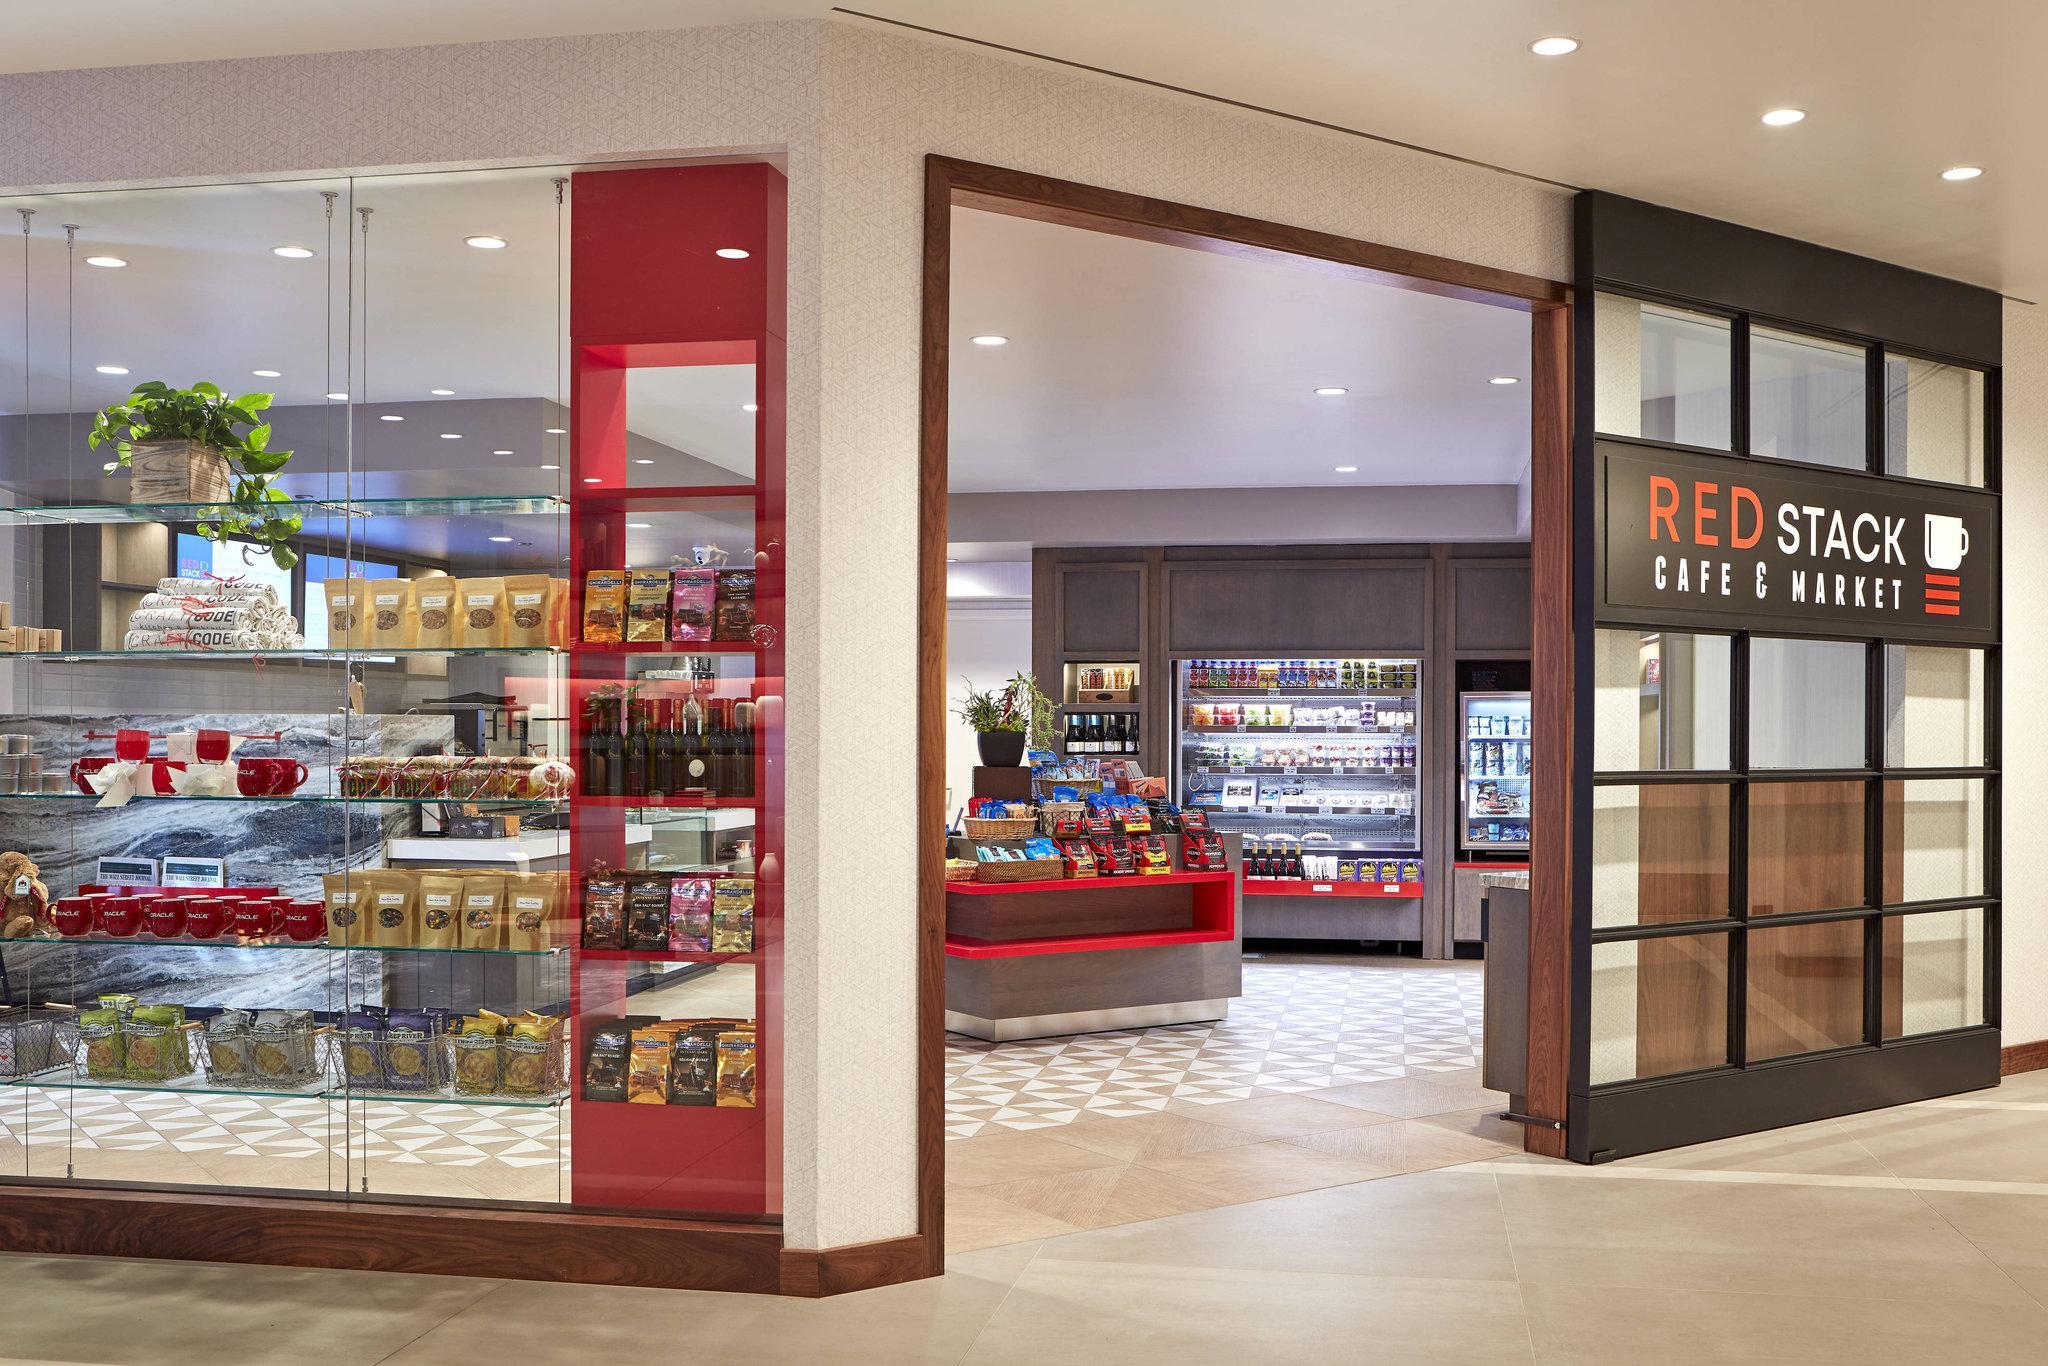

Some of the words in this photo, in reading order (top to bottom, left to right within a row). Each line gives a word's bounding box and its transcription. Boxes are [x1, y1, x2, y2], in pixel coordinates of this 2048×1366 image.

[1649, 474, 1764, 550] RED
[1777, 502, 1907, 566] STACK
[181, 559, 199, 569] RED
[181, 568, 200, 578] STACK
[1654, 555, 1731, 596] CAFE
[1755, 561, 1768, 599] &
[1791, 569, 1902, 610] MARKET
[192, 631, 233, 646] CODE
